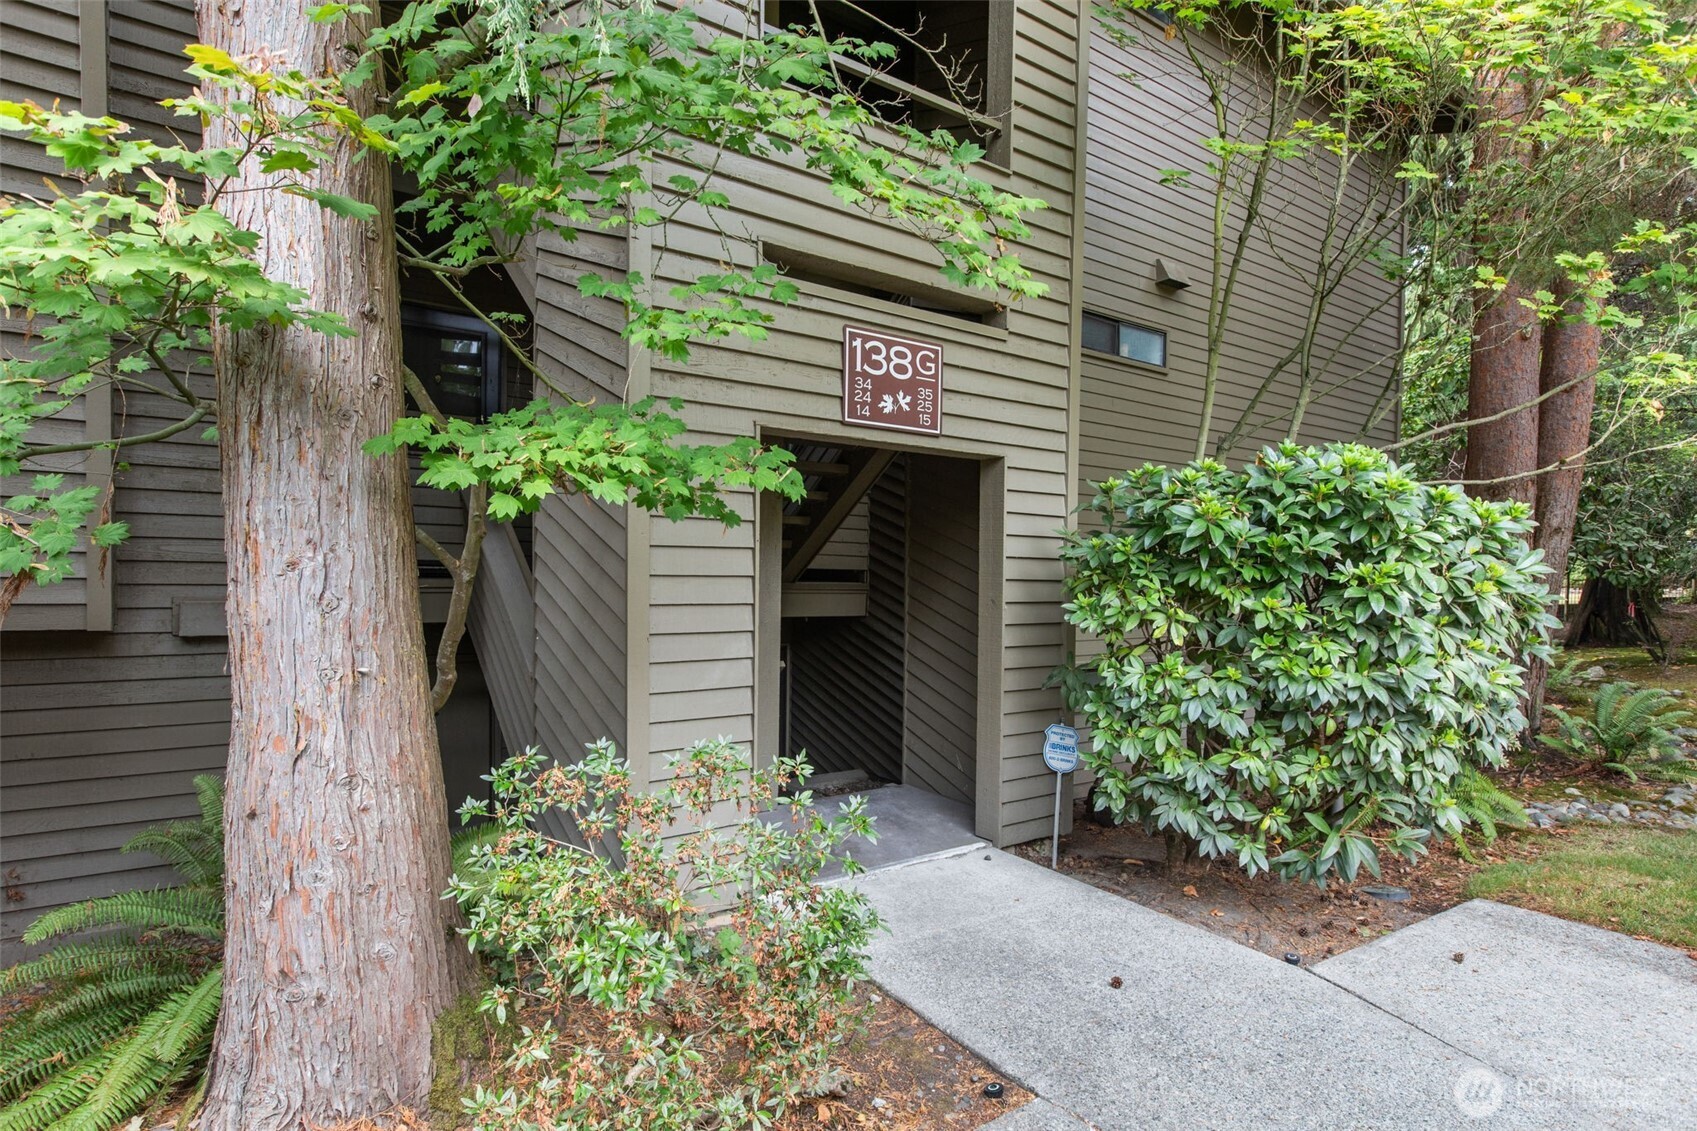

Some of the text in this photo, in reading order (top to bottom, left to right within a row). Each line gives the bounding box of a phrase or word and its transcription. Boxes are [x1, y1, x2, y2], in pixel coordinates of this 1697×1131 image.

[854, 376, 873, 390] 34
[854, 390, 872, 403] 24
[917, 387, 933, 401] 35
[856, 404, 871, 417] 14
[917, 400, 933, 413] 25
[918, 413, 931, 426] 15
[1051, 743, 1076, 753] BRINKS
